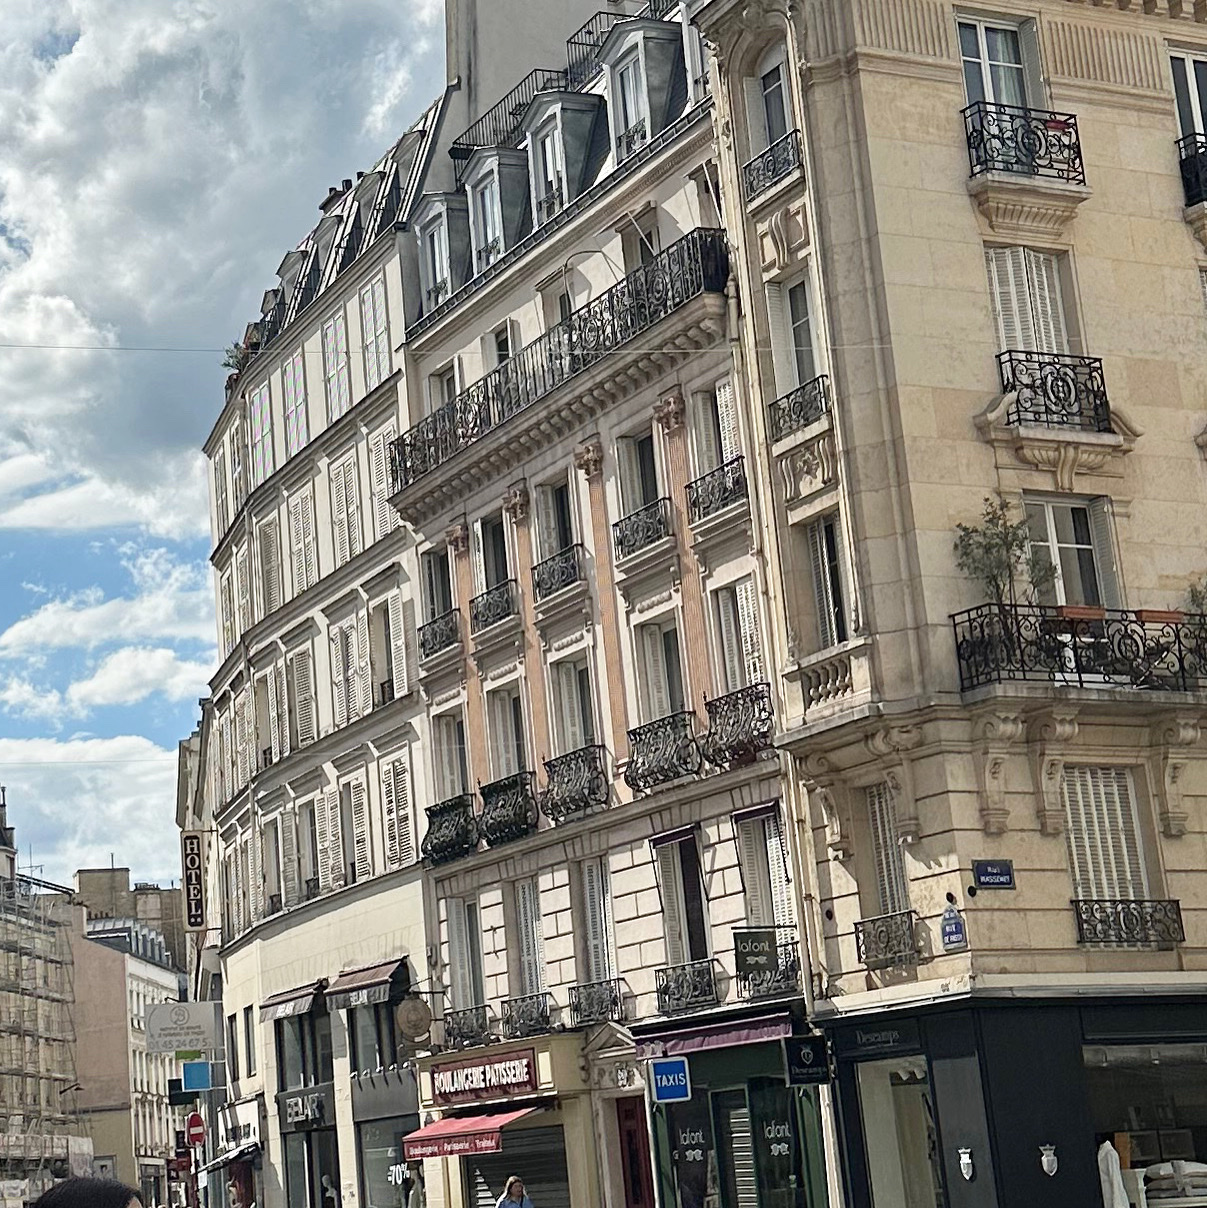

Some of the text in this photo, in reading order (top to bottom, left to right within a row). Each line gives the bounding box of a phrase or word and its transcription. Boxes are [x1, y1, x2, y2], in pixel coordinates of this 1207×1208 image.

[185, 838, 202, 915] HOTEL
[434, 1063, 485, 1095] BOULANGERIE
[656, 1073, 686, 1087] TAXIS
